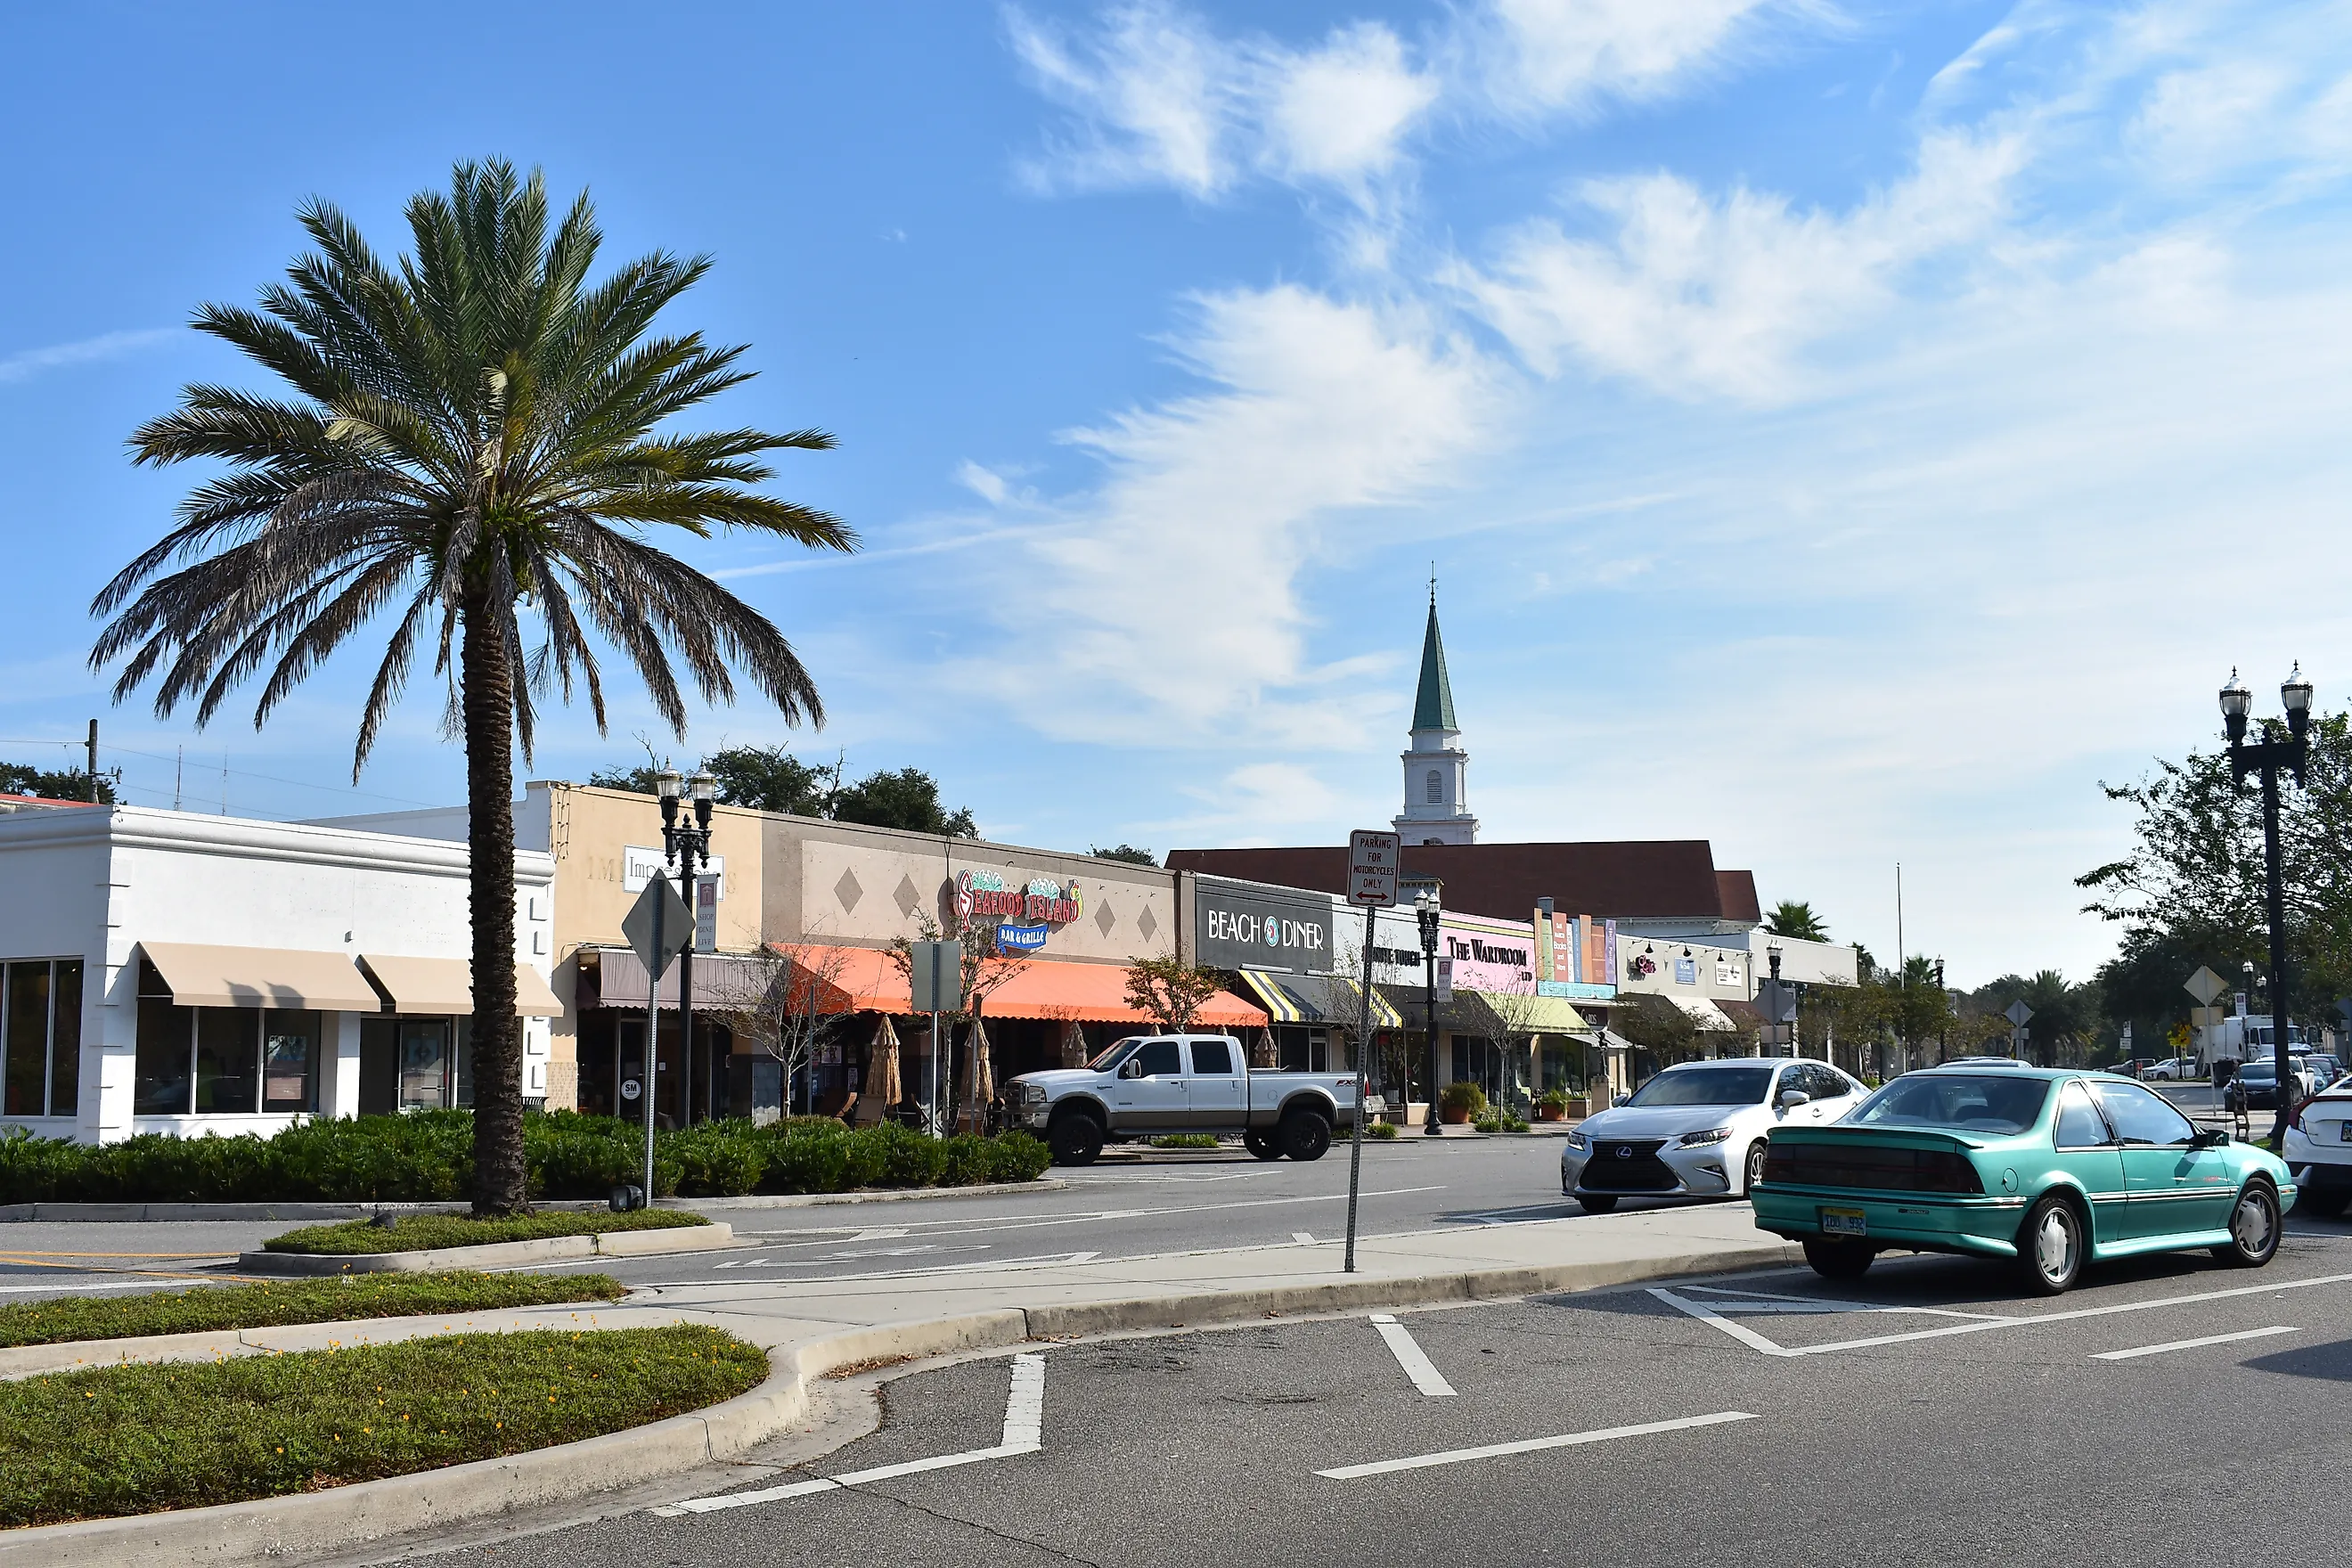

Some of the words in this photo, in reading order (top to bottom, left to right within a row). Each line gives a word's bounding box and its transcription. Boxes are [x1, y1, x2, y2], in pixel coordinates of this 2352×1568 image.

[1360, 837, 1392, 849] PARKING
[1367, 852, 1382, 862] FOR
[1353, 864, 1395, 876] MOTORCYCLES
[1362, 878, 1383, 889] ONLY
[1028, 894, 1080, 924] ISLAND
[698, 913, 714, 921] SHOP
[698, 926, 713, 934] DINE
[1208, 909, 1261, 944] BEACH
[1282, 919, 1324, 951] DINER
[1000, 928, 1014, 943] BAR
[1016, 933, 1022, 943] &
[1022, 930, 1045, 944] GRILLE
[698, 938, 712, 946] LIVE
[1553, 941, 1567, 951] Books
[1521, 971, 1532, 982] LTD
[625, 1084, 637, 1092] SM
